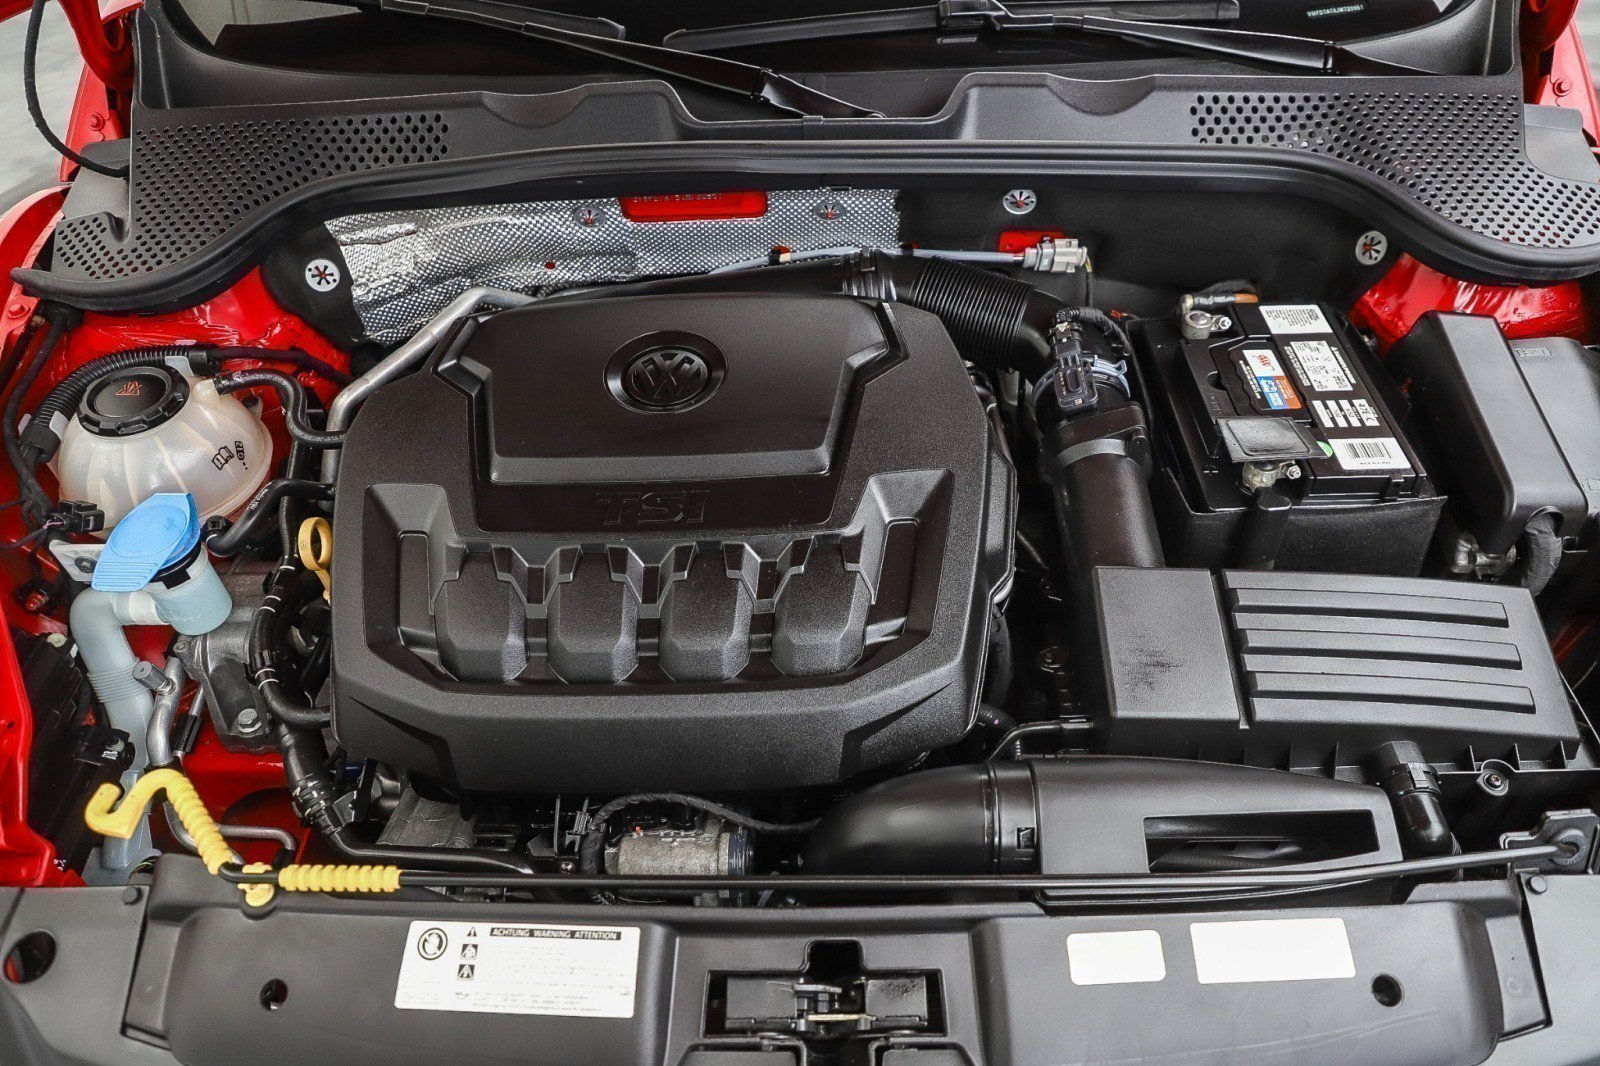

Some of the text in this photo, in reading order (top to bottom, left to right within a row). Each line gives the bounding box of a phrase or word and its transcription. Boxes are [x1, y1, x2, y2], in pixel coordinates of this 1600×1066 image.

[625, 349, 708, 405] VW
[235, 441, 245, 460] G12
[596, 490, 710, 525] TSI
[492, 928, 618, 940] ACHTUNG WARNING ATTENTION
